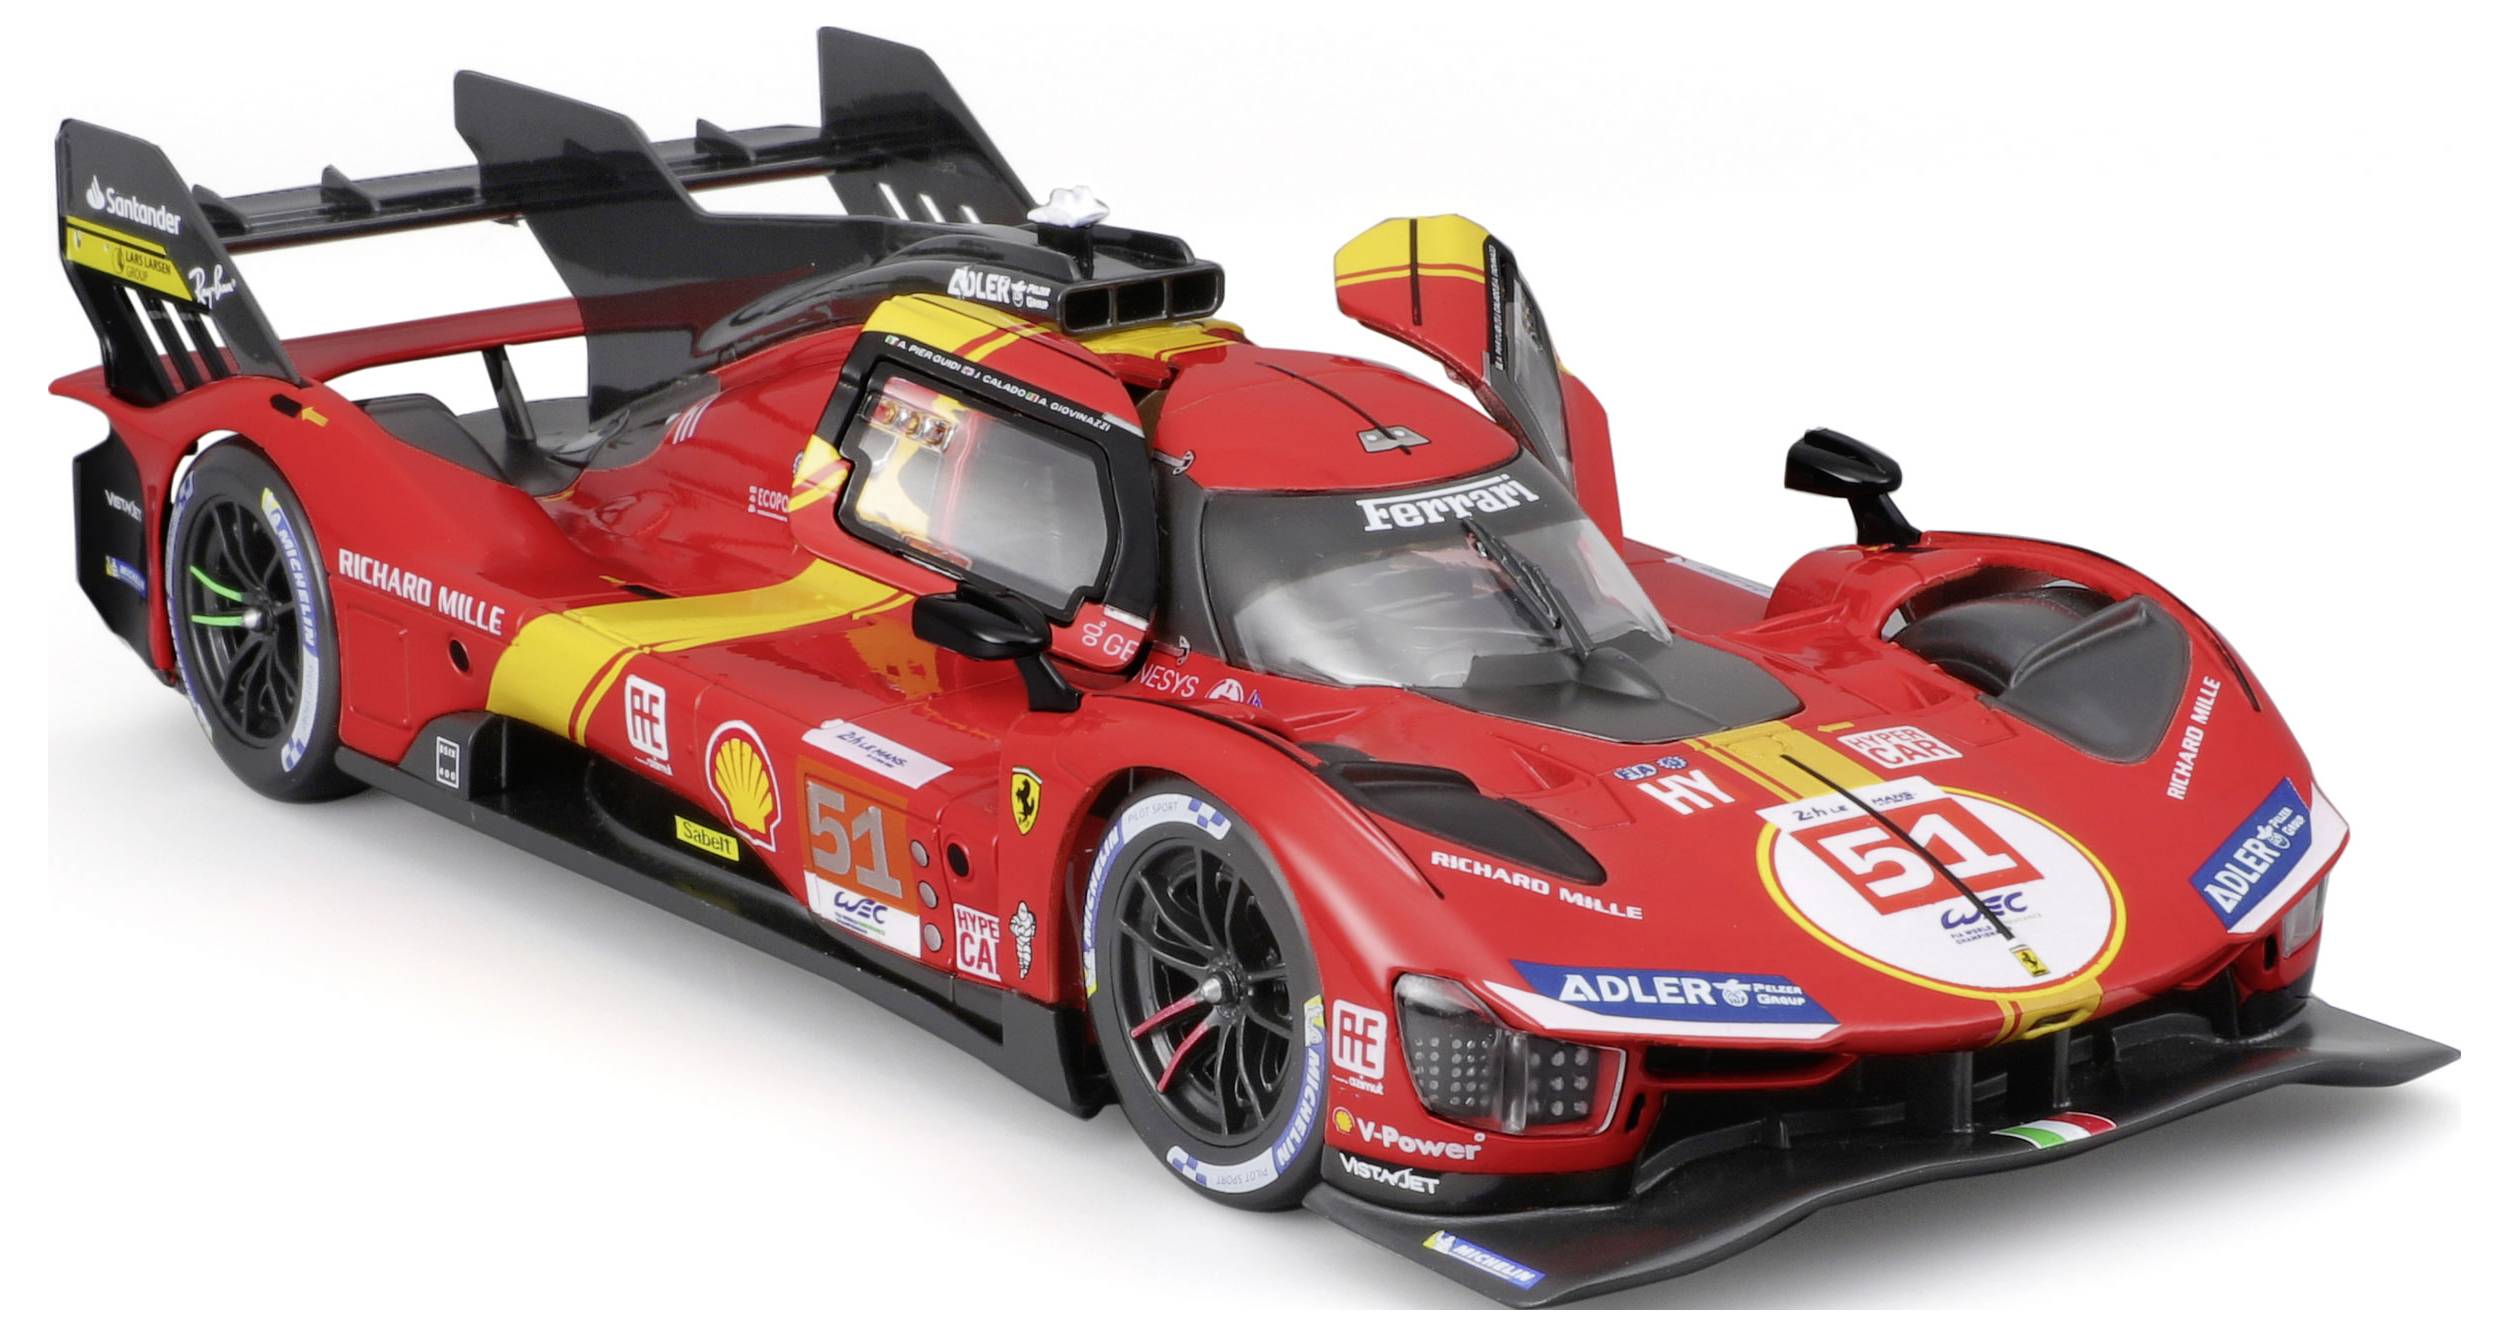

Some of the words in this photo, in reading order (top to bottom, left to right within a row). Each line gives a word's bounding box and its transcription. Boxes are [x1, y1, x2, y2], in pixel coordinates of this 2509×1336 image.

[106, 187, 181, 235] Santander
[125, 251, 143, 266] LARS
[144, 257, 171, 274] LARSEN
[126, 266, 149, 281] GROUP
[947, 266, 1011, 304] ADLER
[908, 345, 933, 361] PIER
[932, 355, 961, 371] GUIDI
[982, 375, 1026, 397] CALADO
[1050, 402, 1111, 432] GIOVINAZZI
[1356, 475, 1539, 532] Ferrari
[276, 528, 318, 647] MICHELIN
[338, 548, 431, 609] RICHARD
[438, 586, 505, 636] MILLE
[1846, 728, 1927, 749] HYPER
[1867, 739, 1955, 764] CAR
[2167, 725, 2203, 800] RICHARD
[2190, 675, 2221, 725] MILLE
[1616, 765, 1654, 779] FIA
[1636, 769, 1736, 815] HY
[1151, 801, 1179, 819] SPORT
[1829, 804, 1849, 814] LE
[806, 780, 903, 899] 51
[1816, 812, 2021, 898] 51
[1083, 824, 1120, 947] MICHELIN
[1431, 850, 1550, 896] RICHARD
[1559, 886, 1643, 921] MILLE
[2203, 837, 2281, 914] ADLER
[834, 890, 888, 925] WEC
[956, 908, 999, 940] HYPE
[1940, 891, 2028, 930] WEC
[1558, 974, 1718, 1006] ADLER
[1755, 994, 1807, 1006] GROUP
[1276, 1047, 1321, 1167] MICHELIN
[1357, 1117, 1482, 1161] V-Power
[1339, 1152, 1440, 1195] VISTAJET
[1453, 1244, 1536, 1282] MICHELIN
